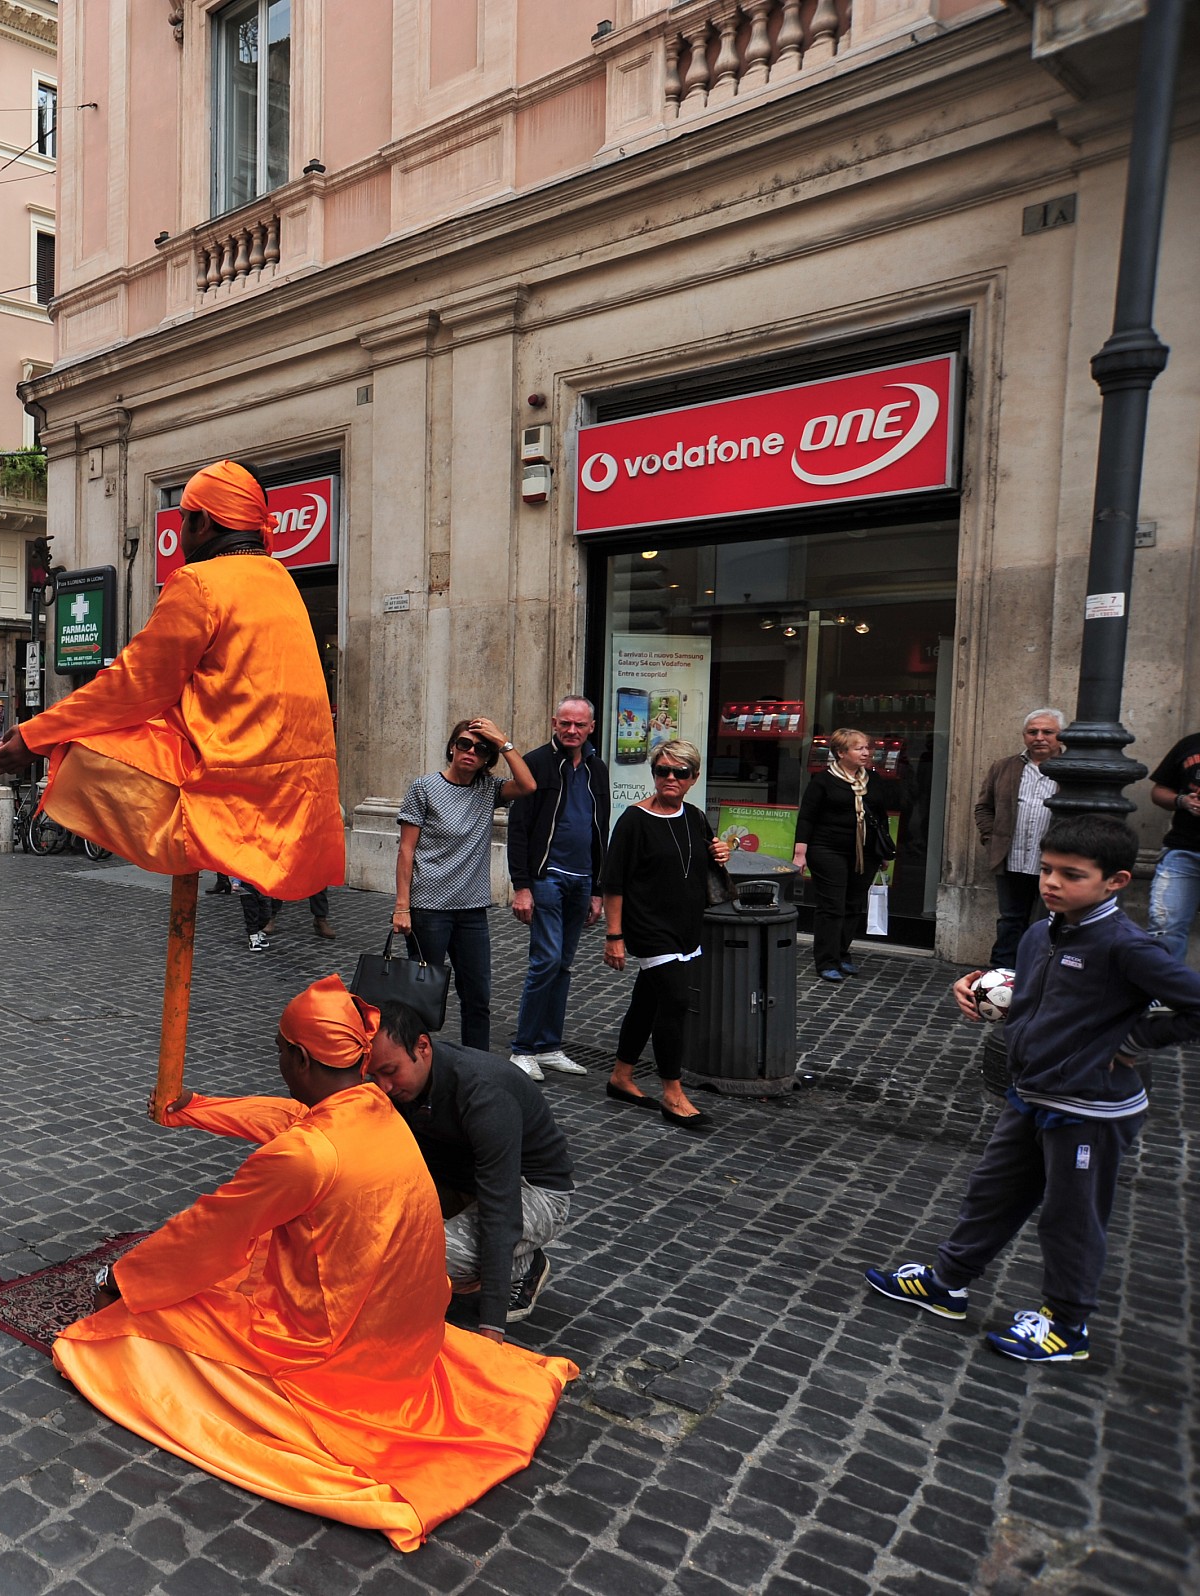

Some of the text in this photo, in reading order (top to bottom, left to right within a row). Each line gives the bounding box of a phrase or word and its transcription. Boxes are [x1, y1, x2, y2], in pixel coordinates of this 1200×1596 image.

[623, 400, 911, 478] vodafone ONE
[62, 623, 97, 634] FARMACIA
[61, 633, 99, 644] PHARMACY
[674, 652, 704, 660] Samsung
[613, 781, 646, 790] Samsung
[728, 807, 752, 815] SCEGLI
[765, 810, 791, 818] MINUTI
